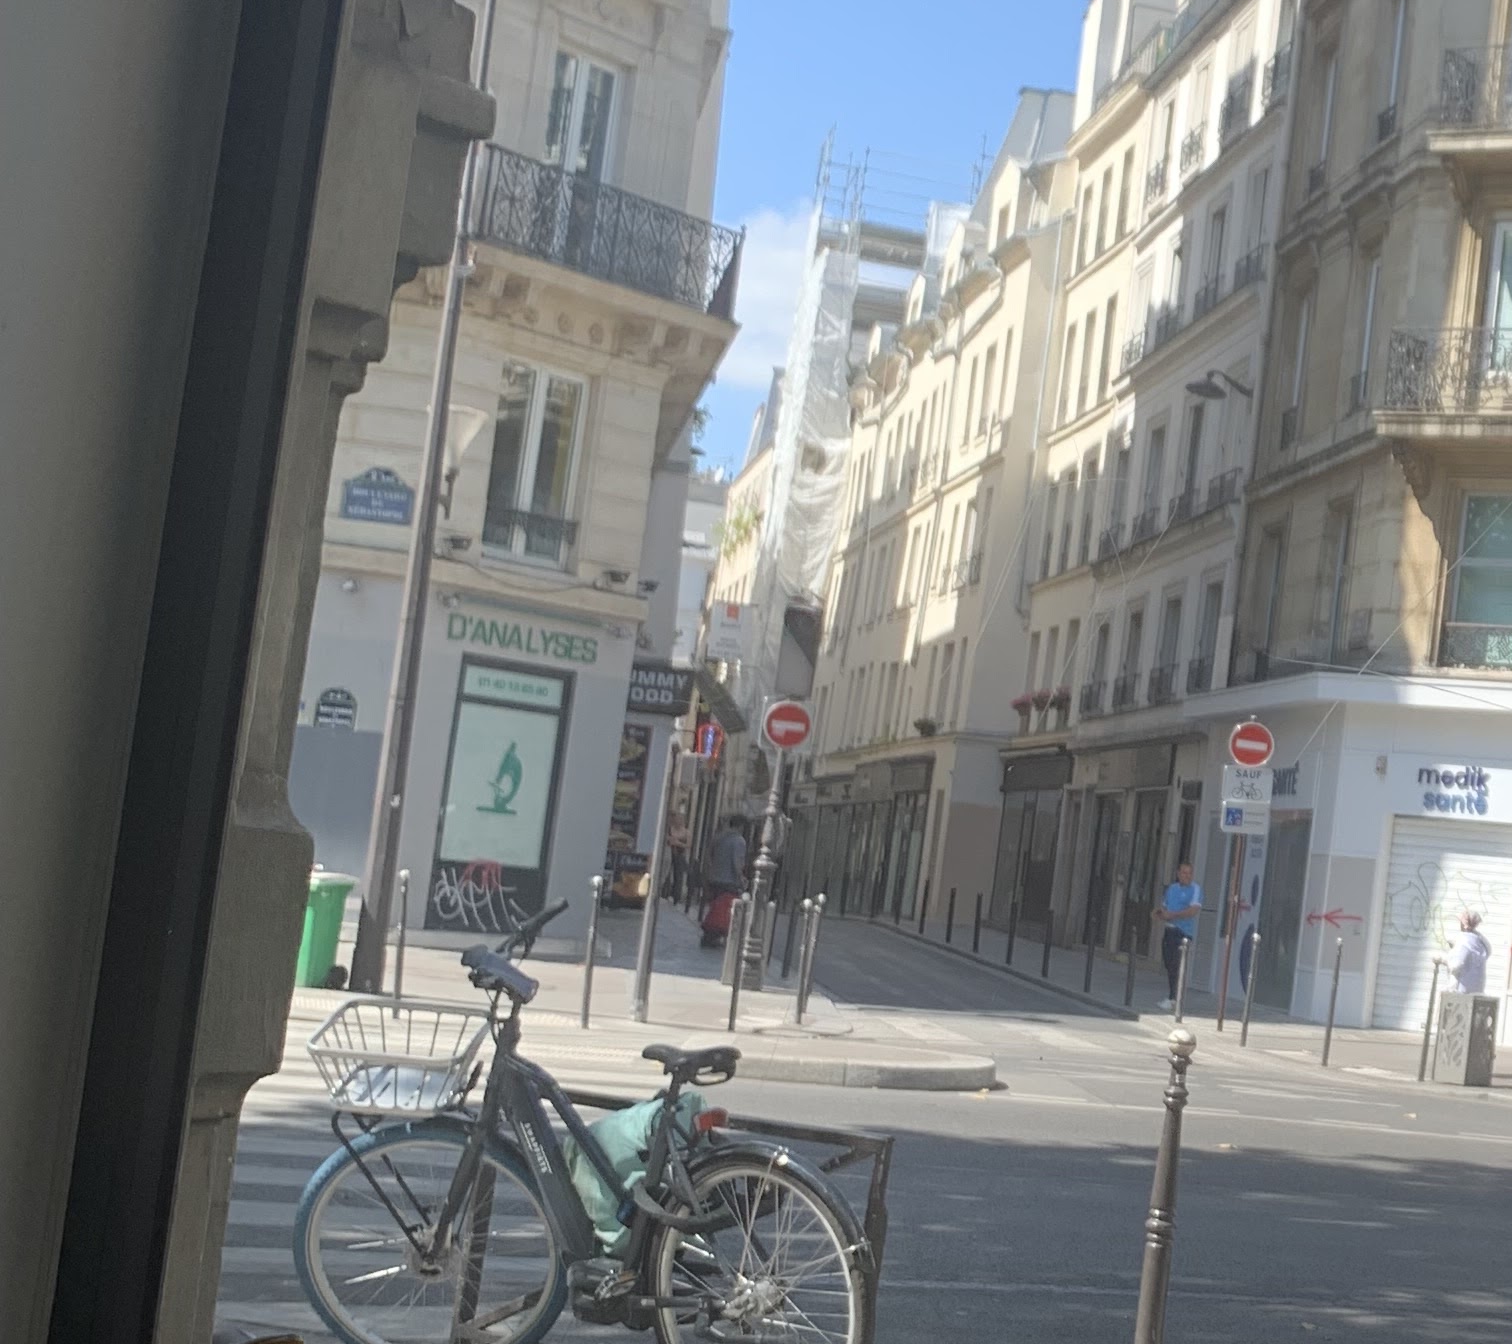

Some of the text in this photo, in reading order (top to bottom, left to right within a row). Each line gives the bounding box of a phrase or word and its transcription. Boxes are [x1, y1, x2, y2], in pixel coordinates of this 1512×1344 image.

[447, 613, 598, 664] D'ANALYSES
[630, 669, 688, 689] UMMY
[630, 686, 674, 704] OOD
[1235, 769, 1262, 779] SAUF
[1418, 765, 1491, 790] medik
[1423, 788, 1488, 815] santé
